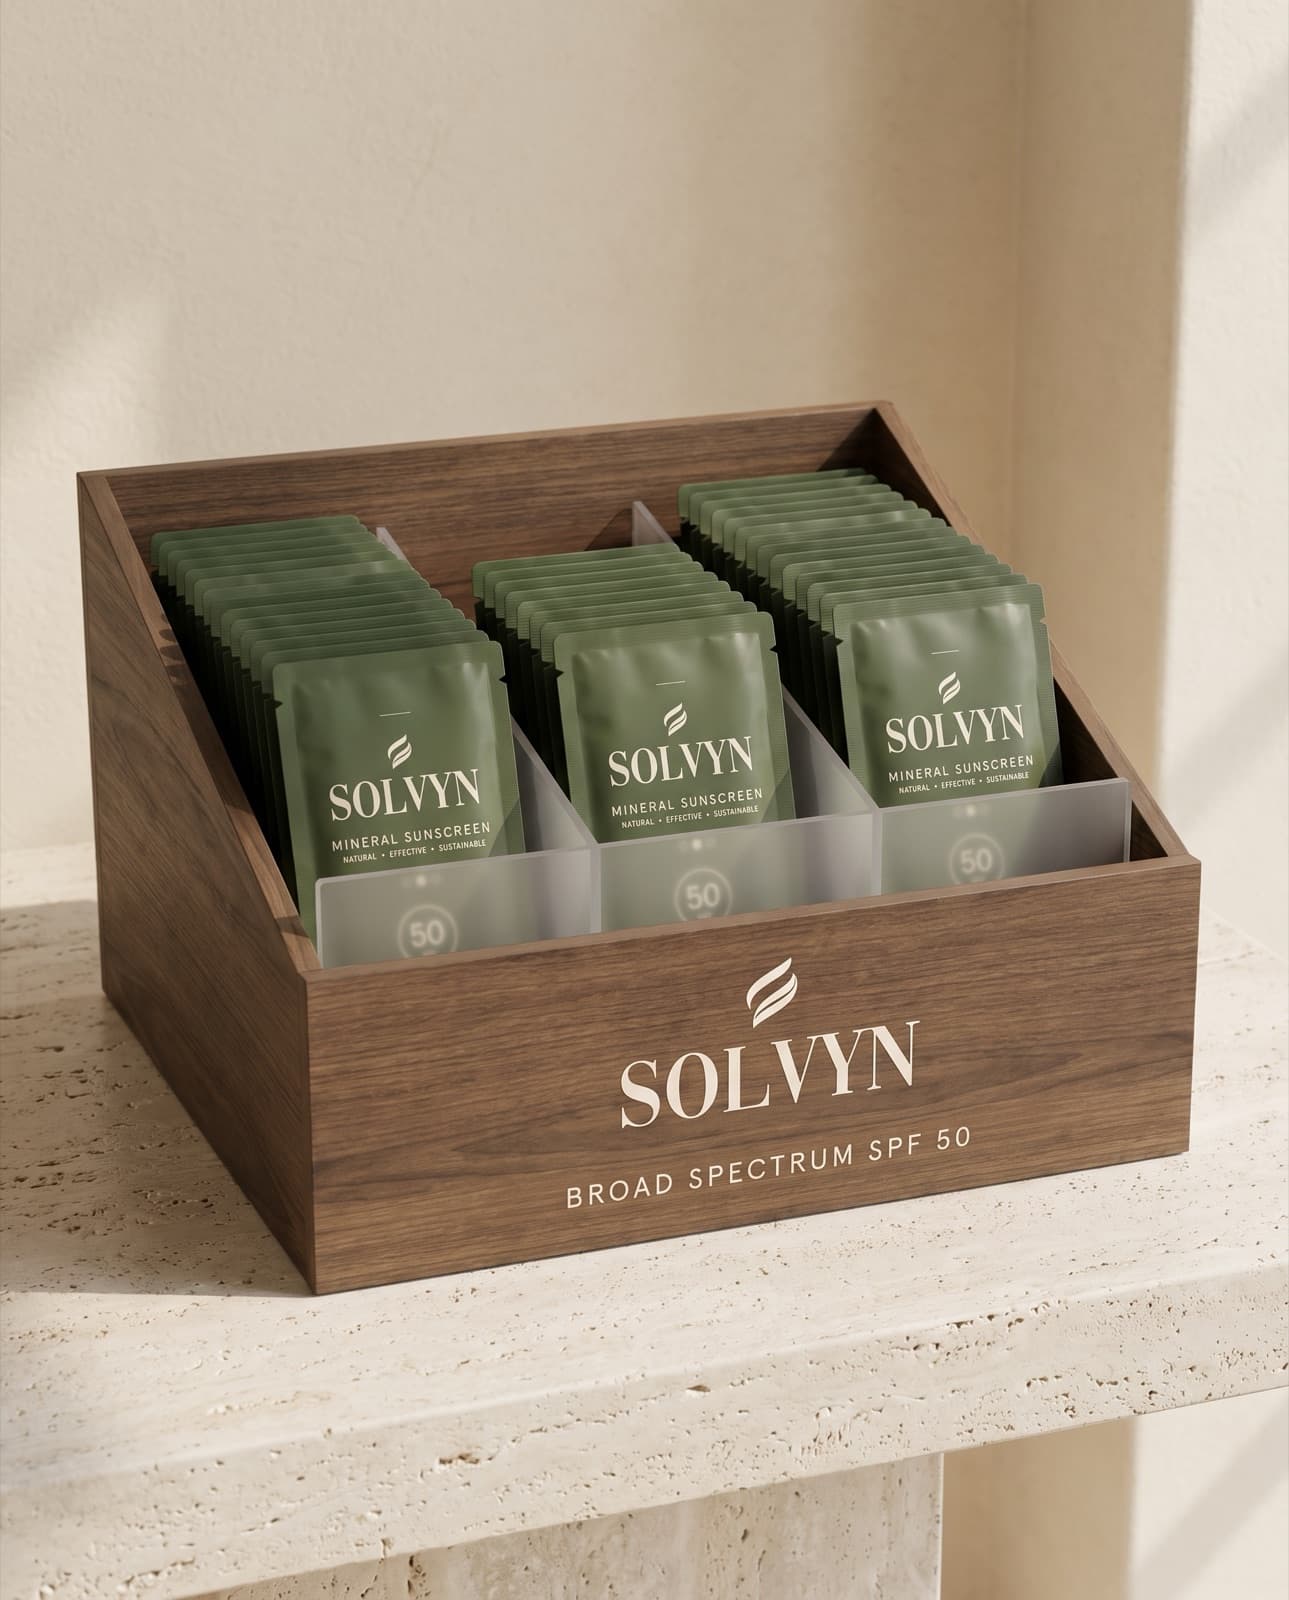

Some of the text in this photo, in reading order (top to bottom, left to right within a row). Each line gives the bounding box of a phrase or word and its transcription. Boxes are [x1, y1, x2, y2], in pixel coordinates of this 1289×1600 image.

[885, 704, 1025, 754] SOLVYN
[608, 736, 753, 788] SOLVYN
[888, 754, 1034, 783] MINERAL SUNSCREEN
[328, 768, 481, 822] SOLVYN
[898, 771, 1030, 795] NATURAL EFFECTIVE SUSTAINABLE
[611, 788, 763, 817] MINERAL SUNSCREEN
[621, 805, 759, 829] NATURAL EFFECTIVE SUSTAINABLE
[332, 821, 491, 852] MINERAL SUNSCREEN
[343, 839, 487, 864] NATURAL EFFECTIVE SUSTAINABLE
[960, 848, 993, 874] 50
[686, 882, 721, 911] 50
[409, 919, 445, 948] 50
[620, 1020, 921, 1129] SOLVYN
[567, 1126, 971, 1209] BROAD SPECTRUM SPF 50
